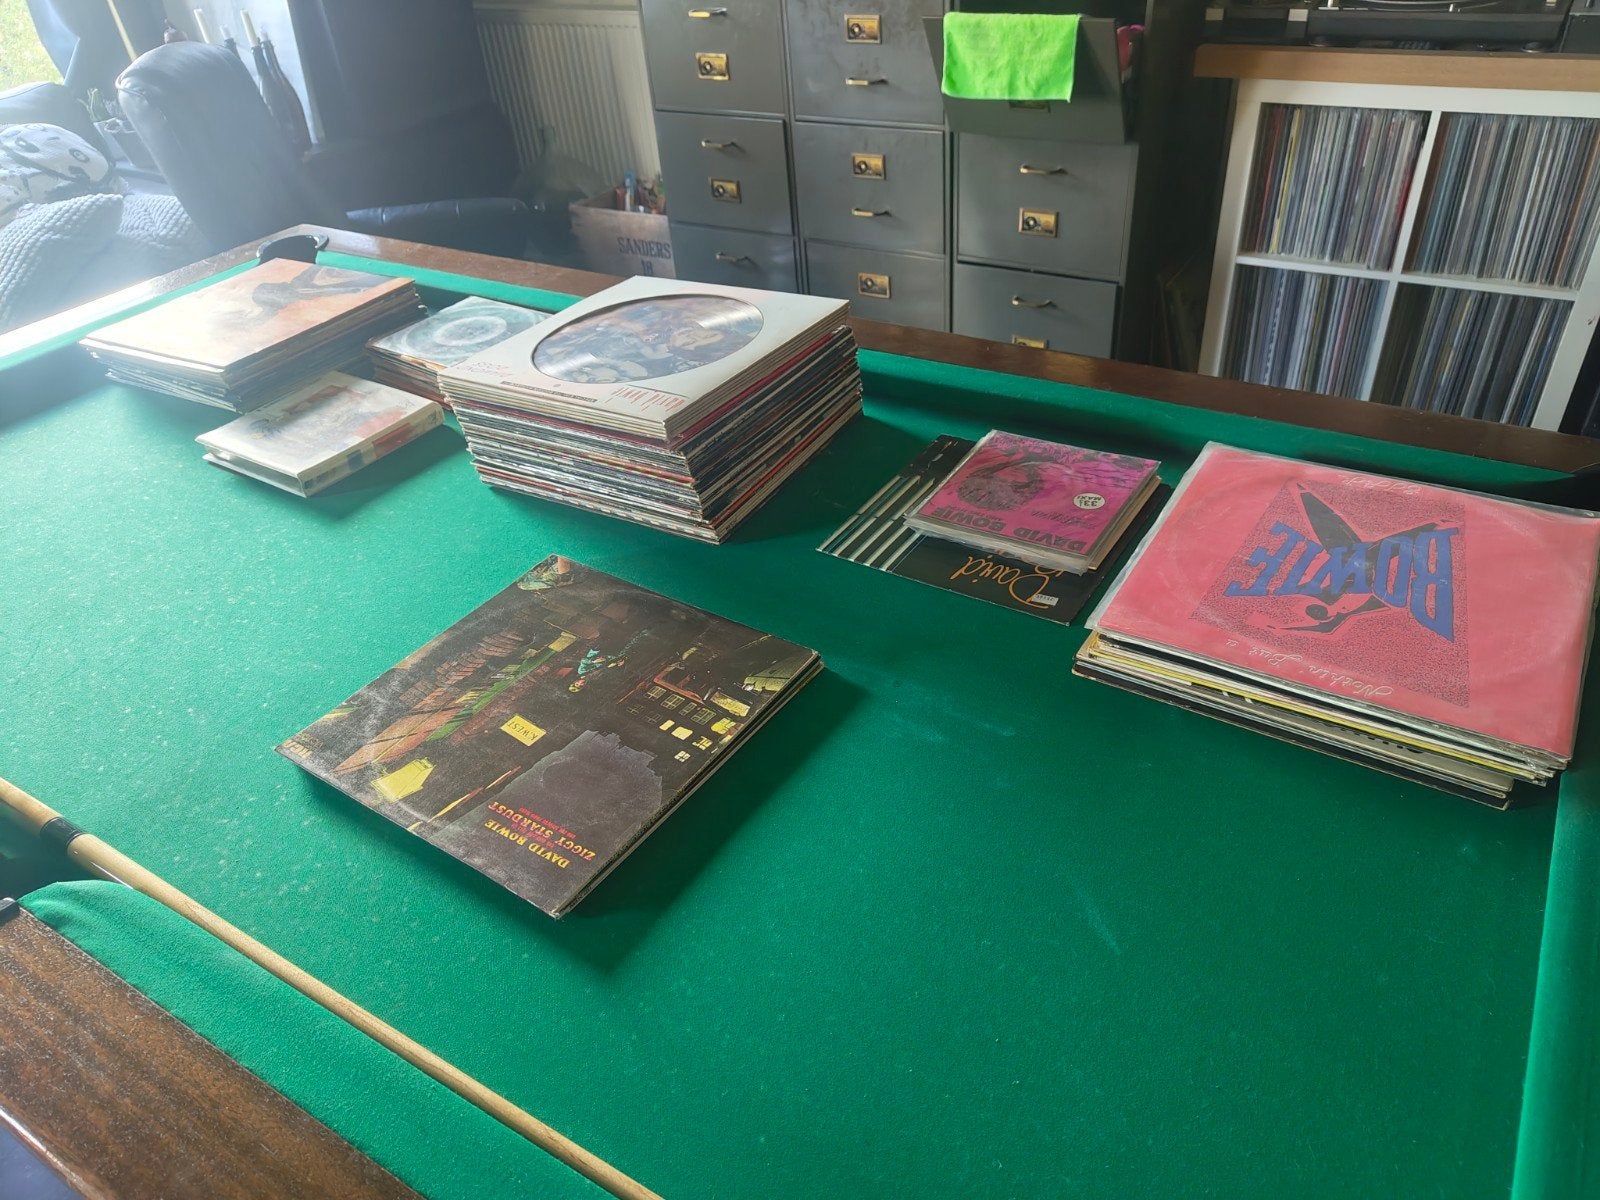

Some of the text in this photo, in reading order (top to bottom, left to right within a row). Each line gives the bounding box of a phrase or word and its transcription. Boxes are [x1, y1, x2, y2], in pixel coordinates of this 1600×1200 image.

[617, 236, 672, 259] SANDERS
[930, 506, 1007, 532] BOWIE
[1012, 526, 1088, 551] DAVID
[950, 555, 1049, 609] David
[1223, 520, 1459, 643] BOWIE
[484, 818, 528, 846] BOWIE
[488, 801, 554, 838] STARDUST
[528, 842, 571, 869] DAVID
[555, 836, 597, 861] ZIGGY
